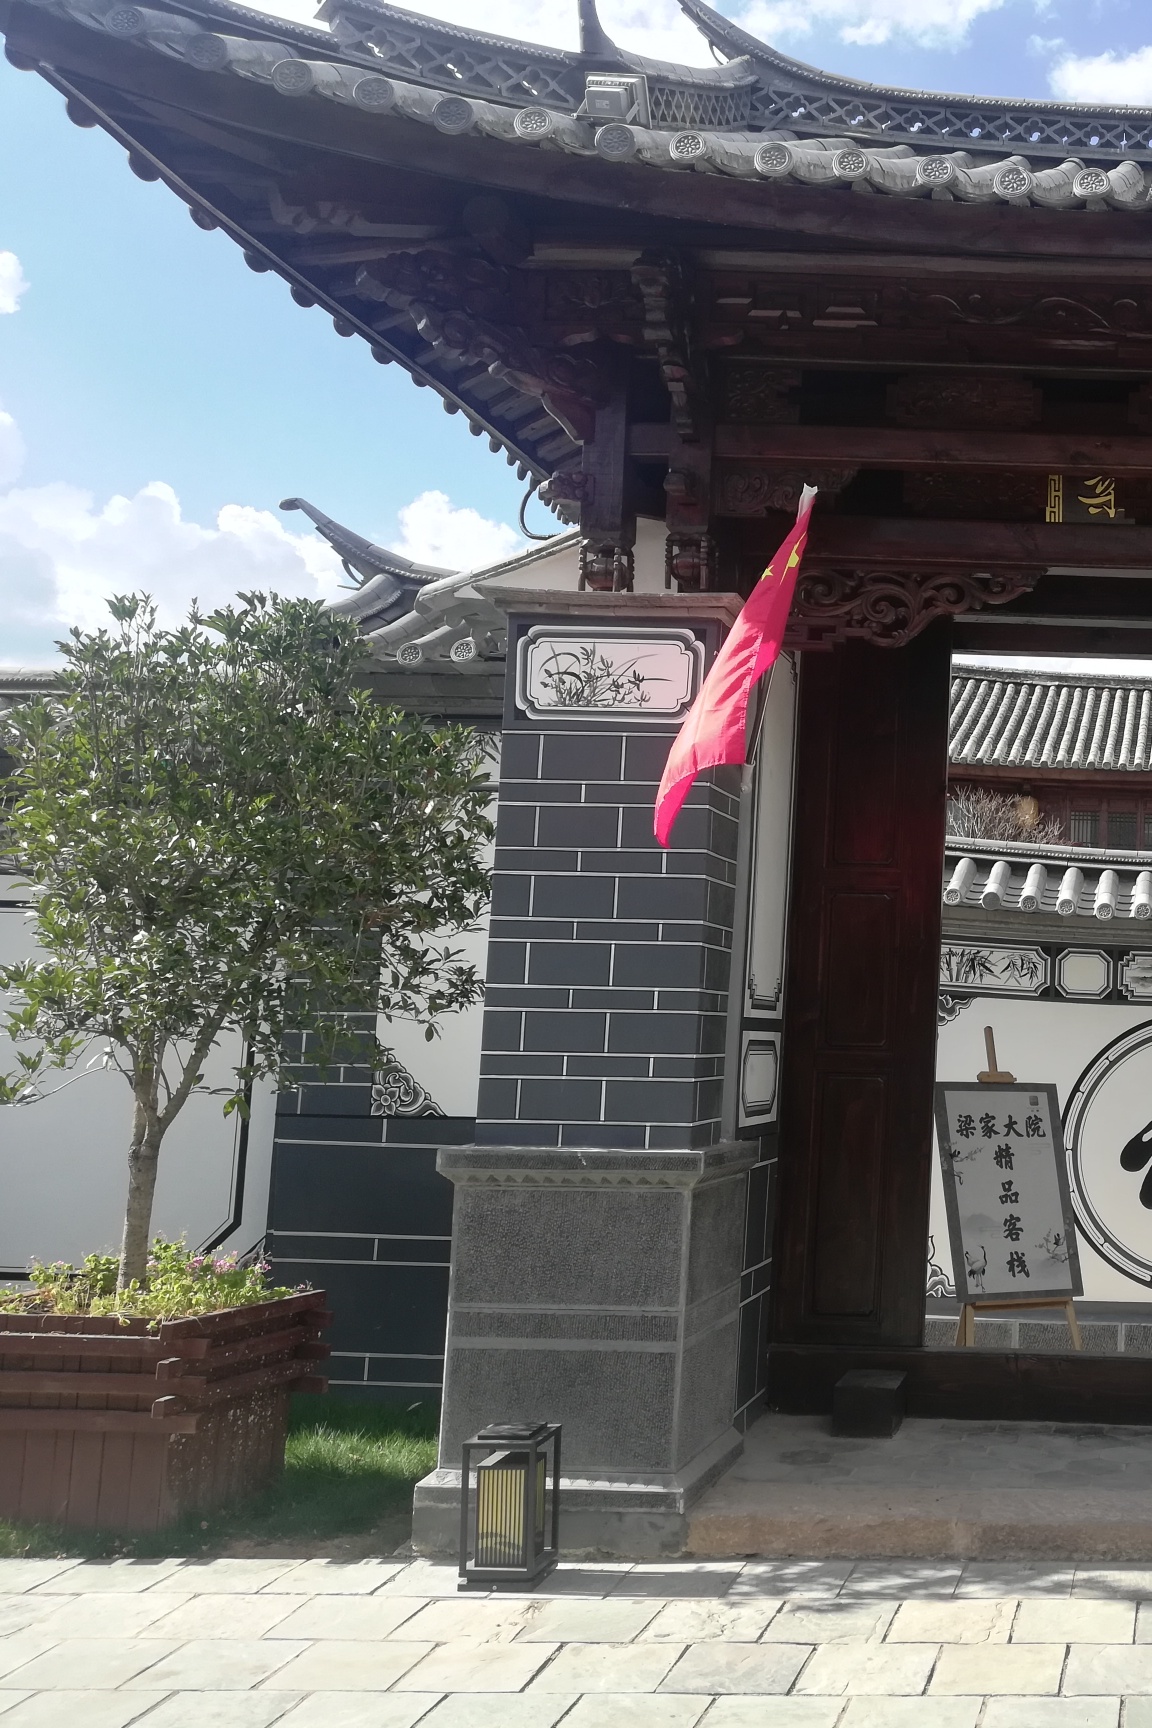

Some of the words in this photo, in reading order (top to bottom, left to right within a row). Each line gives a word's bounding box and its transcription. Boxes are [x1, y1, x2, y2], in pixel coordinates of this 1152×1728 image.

[956, 1112, 1047, 1139] 梁家大院
[993, 1143, 1030, 1278] 精品客栈
